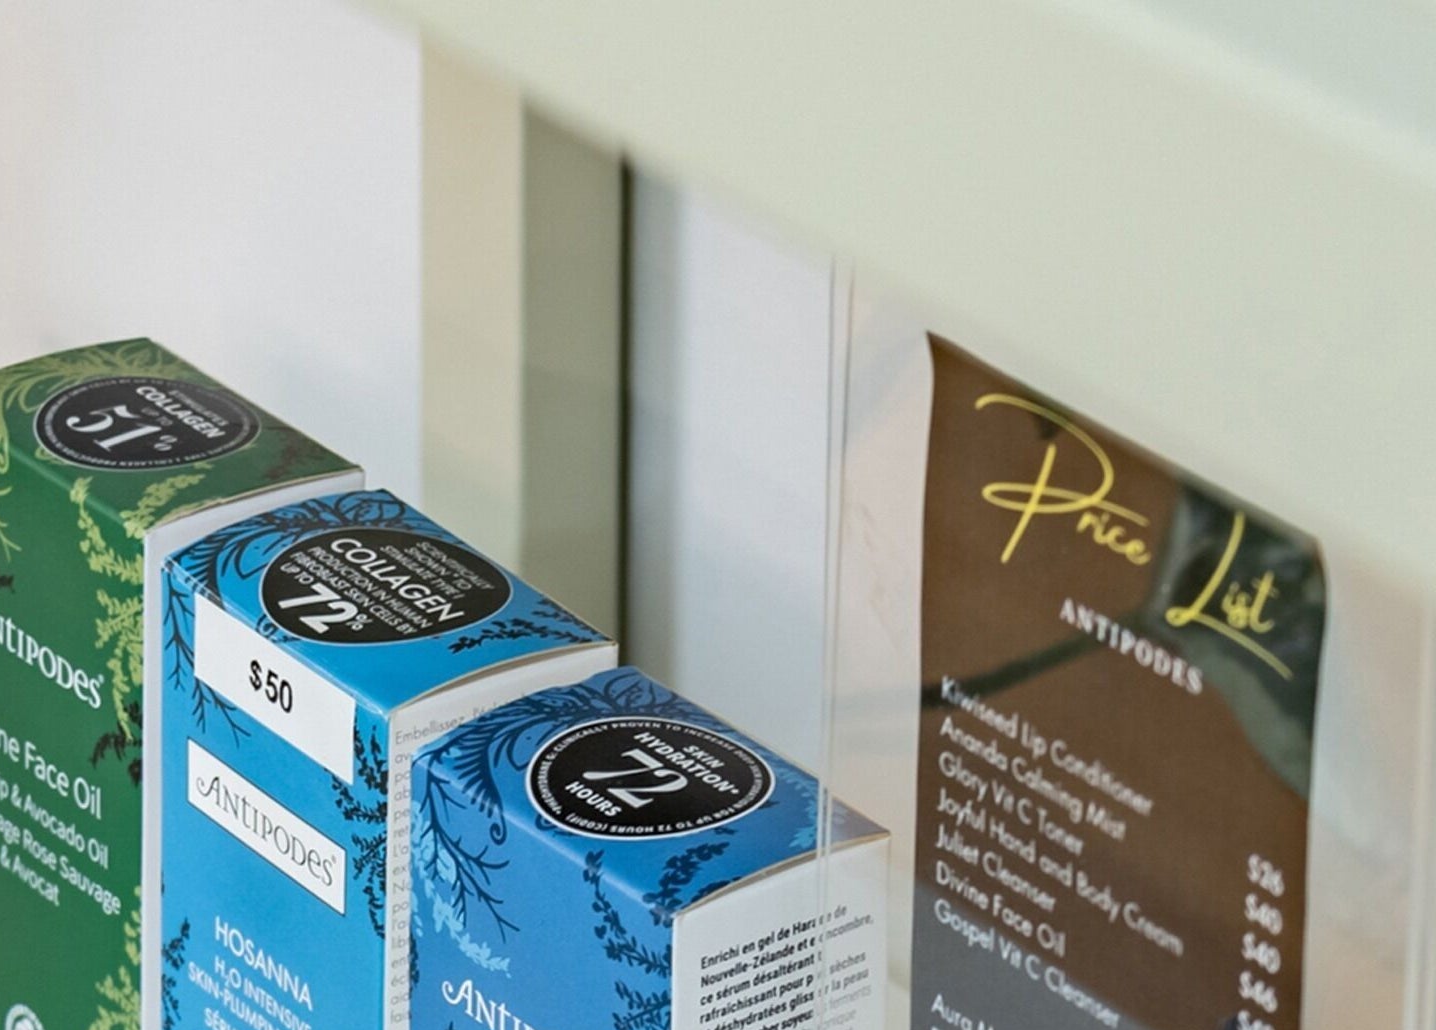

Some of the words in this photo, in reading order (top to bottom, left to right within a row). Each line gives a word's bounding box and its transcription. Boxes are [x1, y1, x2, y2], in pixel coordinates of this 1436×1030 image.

[136, 386, 224, 438] COLLAGEN
[279, 562, 301, 574] UP
[294, 570, 314, 585] TO
[974, 392, 1151, 566] Price
[1164, 510, 1295, 681] List
[290, 551, 350, 590] FIBROBLAST
[343, 587, 374, 608] SKIN
[368, 604, 403, 626] CELLS
[395, 622, 417, 635] BY
[308, 546, 377, 592] PRODUCTION
[371, 589, 391, 601] IN
[385, 598, 432, 628] HUMAN
[330, 538, 463, 621] COLLAGEN
[248, 659, 294, 714] $50
[1059, 597, 1205, 696] ANTIPODES
[24, 741, 69, 797] Face
[72, 777, 101, 820] Oil
[583, 749, 687, 808] 72
[682, 745, 724, 769] SKIN
[10, 783, 22, 809] &
[23, 795, 85, 853] Avocado
[87, 838, 109, 870] Oil
[564, 781, 621, 816] HOURS
[938, 752, 988, 802] Glory
[991, 781, 1015, 813] Vit
[1016, 797, 1032, 826] C
[1037, 808, 1083, 855] Toner
[0, 845, 11, 870] &
[12, 855, 59, 906] Avocat
[22, 829, 57, 871] Rose
[59, 856, 121, 916] Sauvage
[935, 861, 989, 910] Divine
[992, 894, 1033, 938] Face
[1036, 923, 1066, 958] Oil
[982, 852, 1055, 911] Cleanser
[214, 917, 312, 1010] HOSANNA
[700, 947, 740, 970] Enrichi
[741, 941, 756, 955] en
[757, 931, 775, 951] gel
[776, 927, 791, 942] de
[934, 899, 995, 951] Gospel
[998, 937, 1022, 969] Vit
[1024, 955, 1040, 982] C
[1044, 967, 1119, 1028] Cleanser
